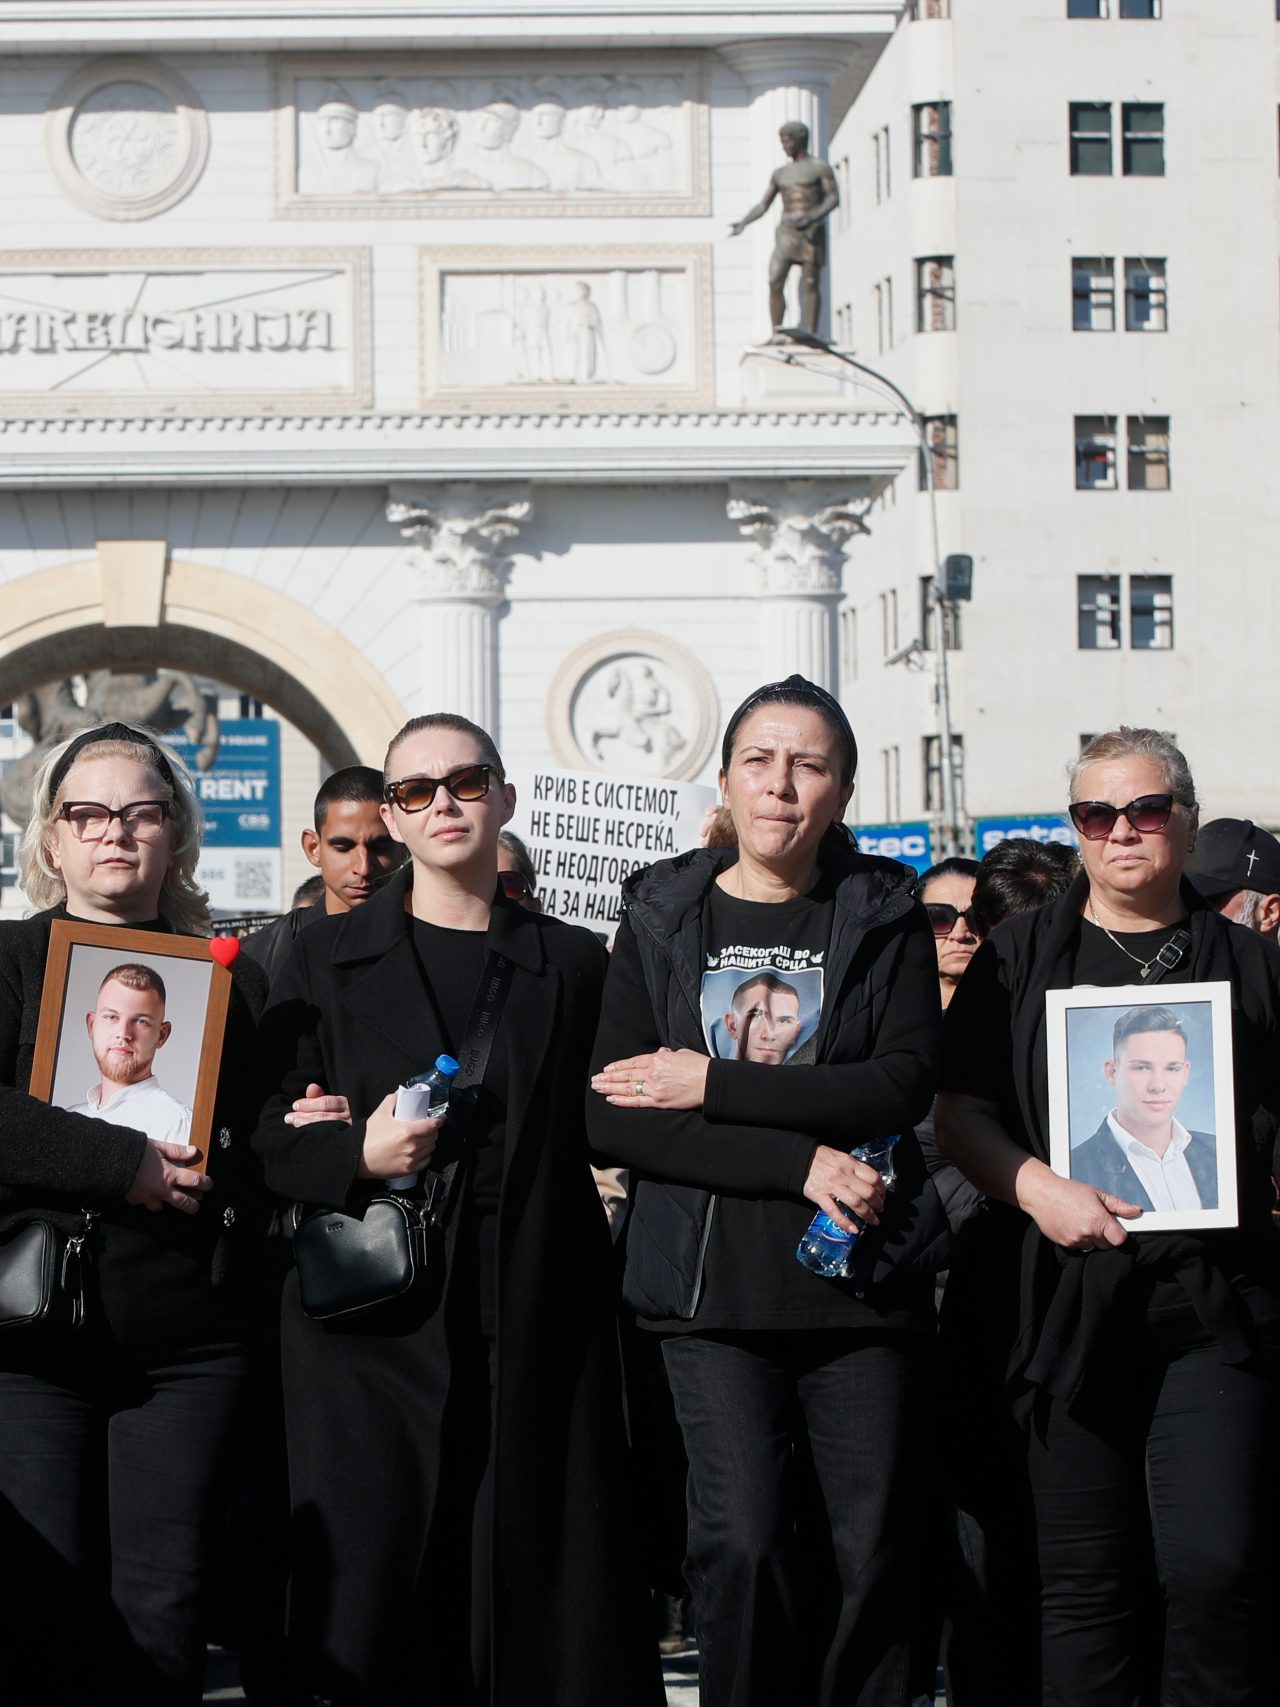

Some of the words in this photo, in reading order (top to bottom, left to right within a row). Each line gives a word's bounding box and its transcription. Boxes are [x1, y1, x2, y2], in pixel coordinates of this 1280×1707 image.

[200, 779, 268, 800] RENT
[534, 774, 577, 804] КРИВ
[582, 780, 590, 806] Е
[595, 782, 680, 821] СИСТЕМОТ,
[531, 810, 551, 838] НЕ
[555, 813, 600, 844] БЕШЕ
[604, 820, 679, 854] НЕСРЕЌА.
[858, 835, 926, 857] tec
[555, 851, 651, 888] НЕОДГОВ
[560, 890, 580, 918] ЗА
[720, 945, 791, 958] ЗАСЕКОГАШ
[793, 949, 811, 960] ВО
[720, 956, 772, 968] НАШИТЕ
[775, 956, 808, 971] СРЦА
